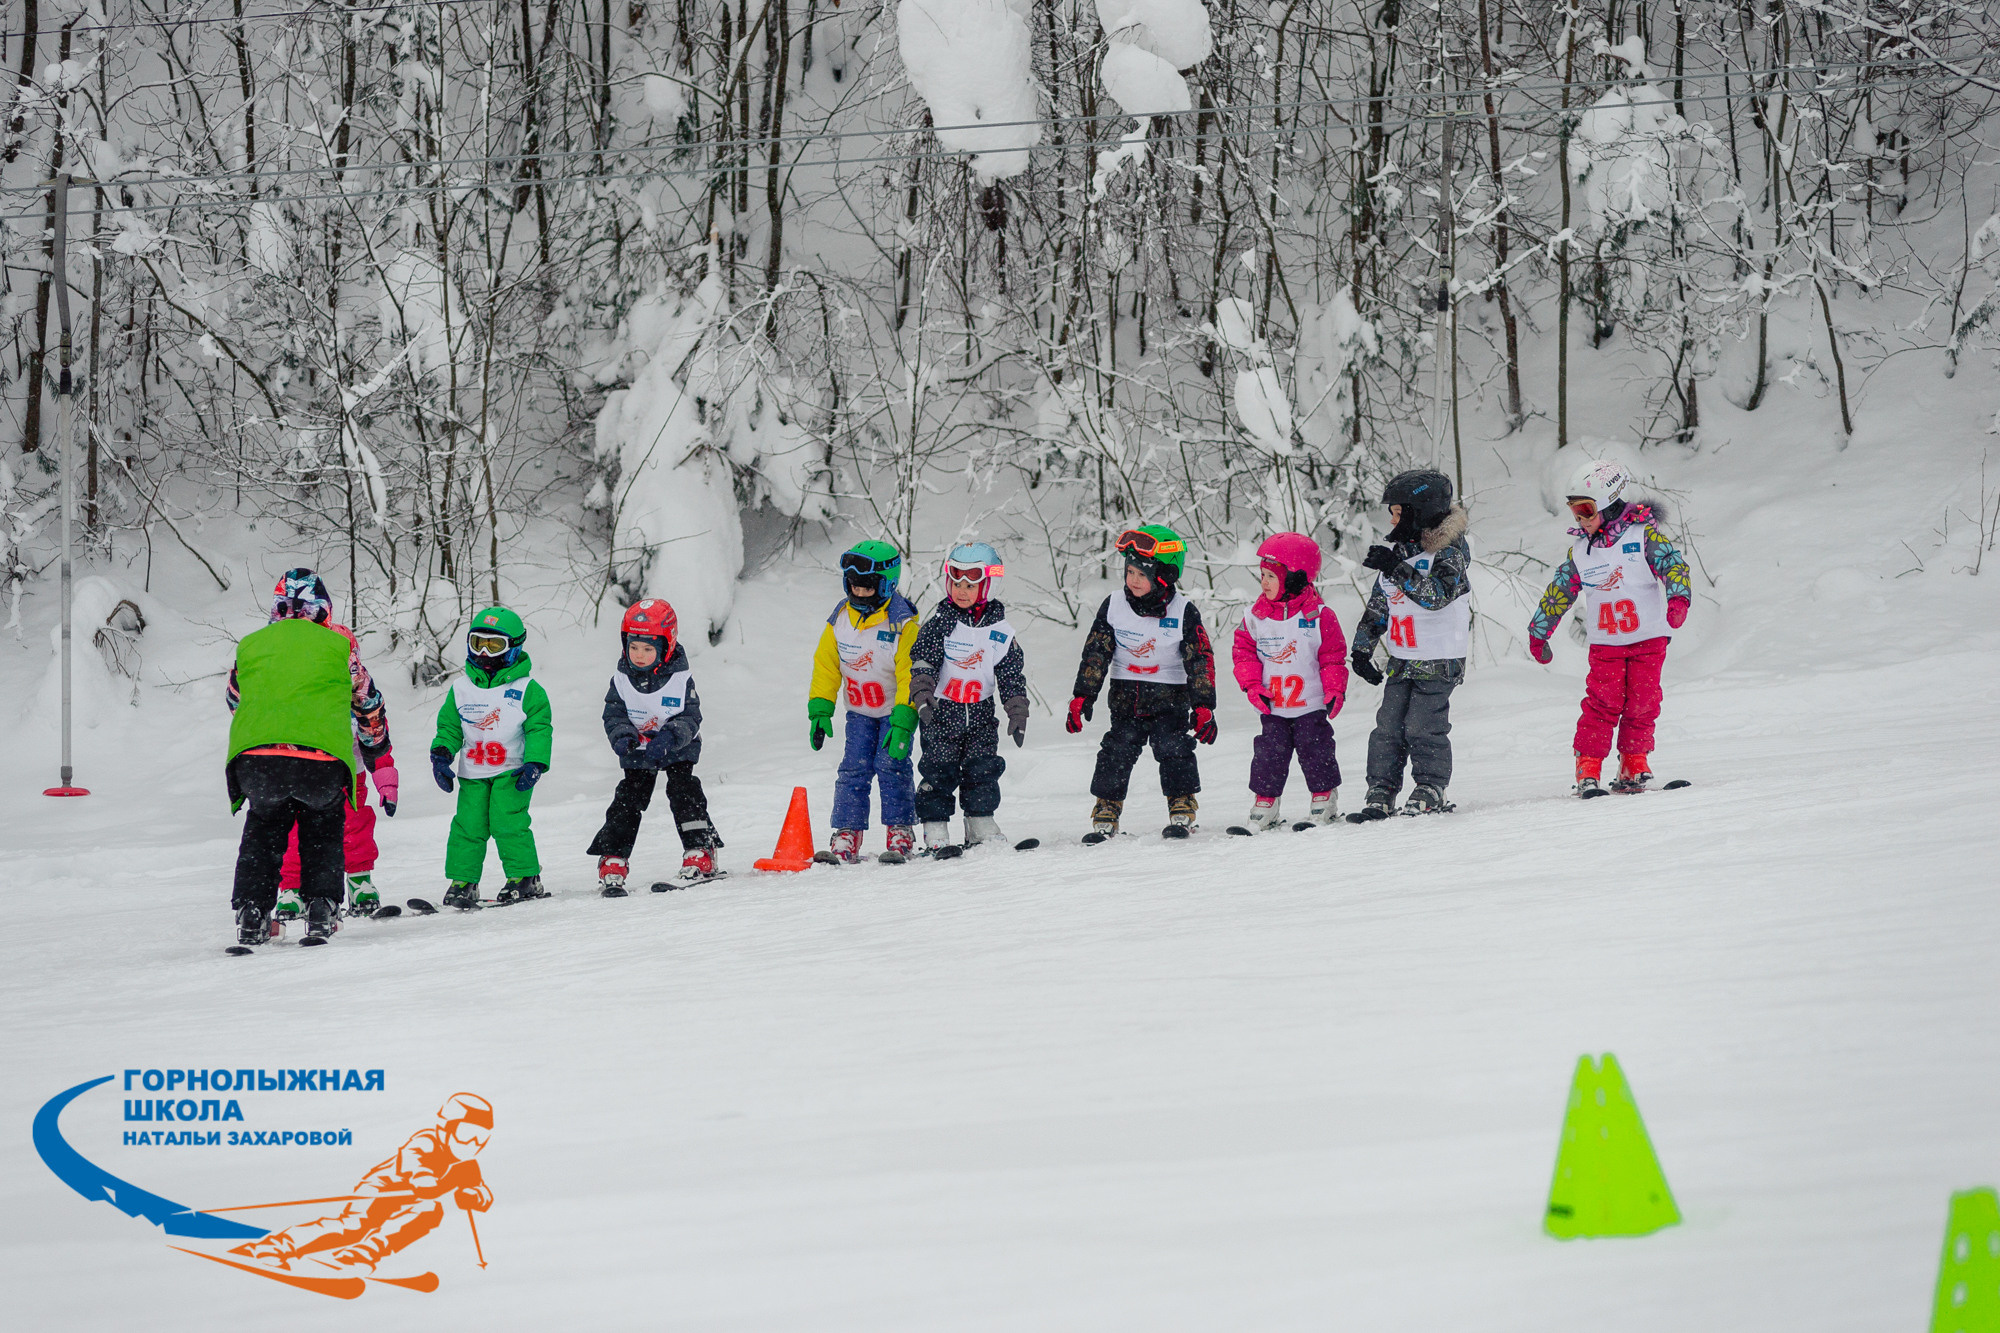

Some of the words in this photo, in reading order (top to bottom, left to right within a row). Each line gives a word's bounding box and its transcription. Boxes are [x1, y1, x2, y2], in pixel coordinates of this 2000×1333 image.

[1606, 473, 1621, 487] uvex
[1390, 615, 1418, 648] 41
[1597, 599, 1640, 635] 43
[846, 676, 886, 708] 50
[1268, 674, 1307, 709] 42
[466, 741, 507, 767] 49
